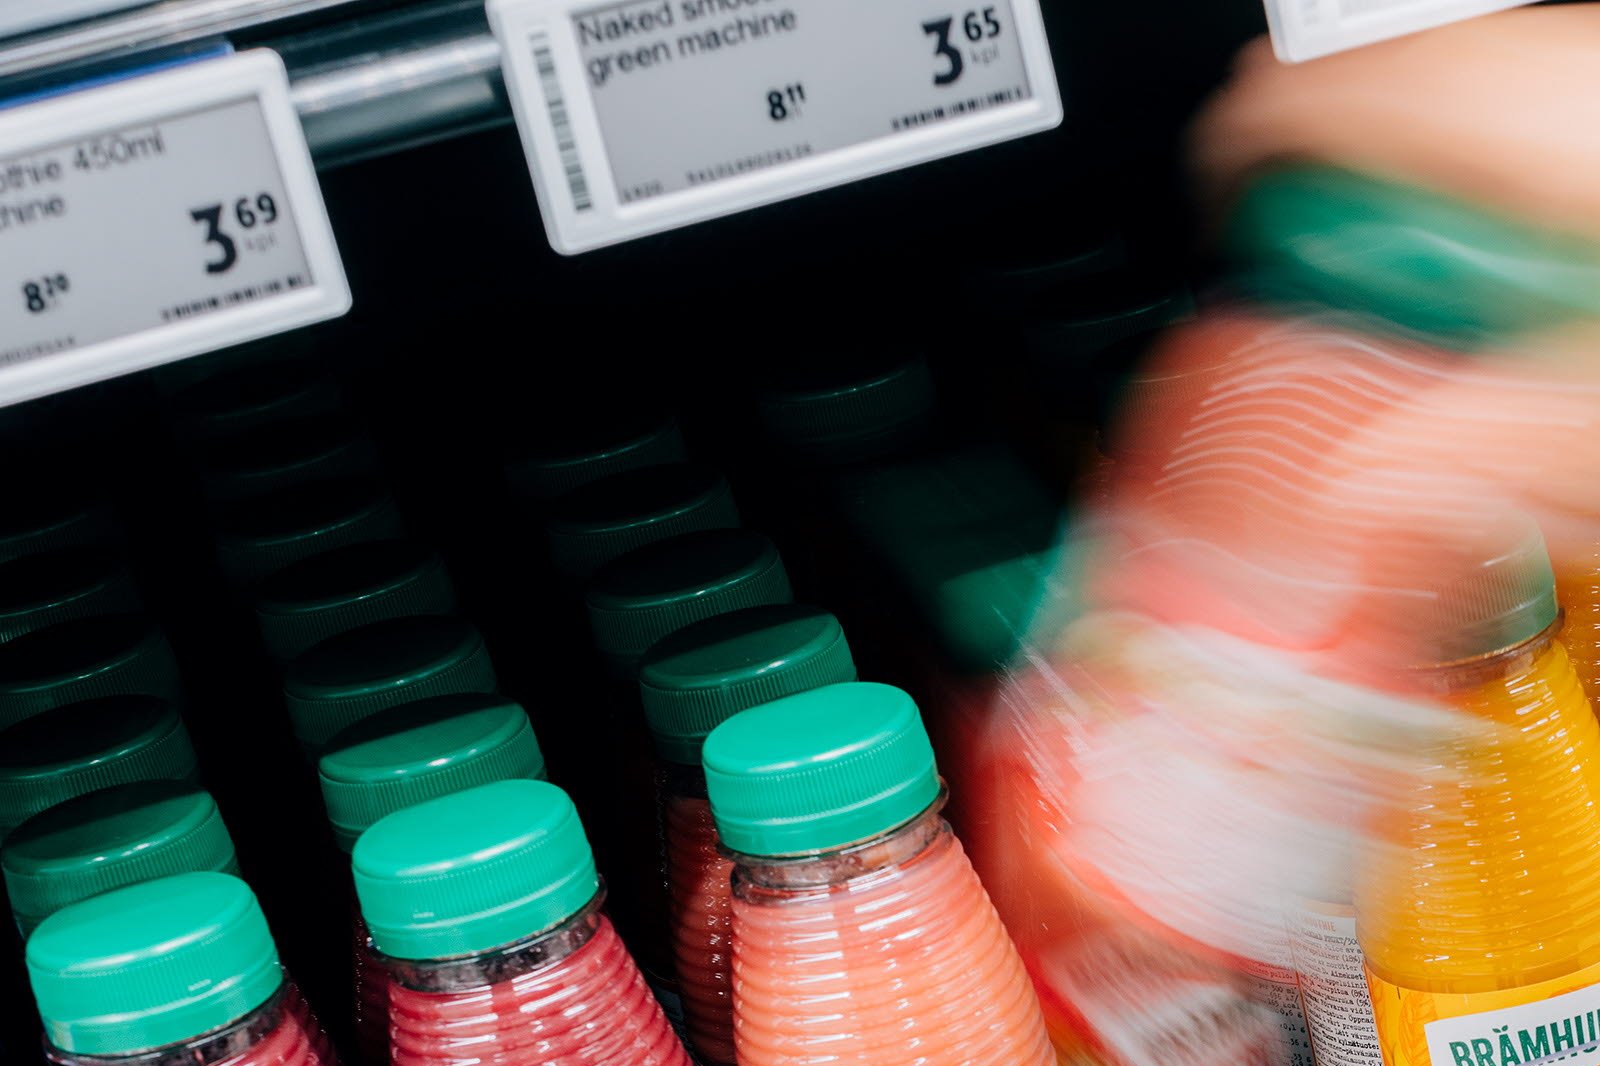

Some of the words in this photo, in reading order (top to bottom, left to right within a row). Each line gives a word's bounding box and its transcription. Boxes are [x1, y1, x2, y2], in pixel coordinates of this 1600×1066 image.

[577, 3, 674, 46] Naked
[587, 40, 672, 88] green
[678, 9, 797, 56] machine
